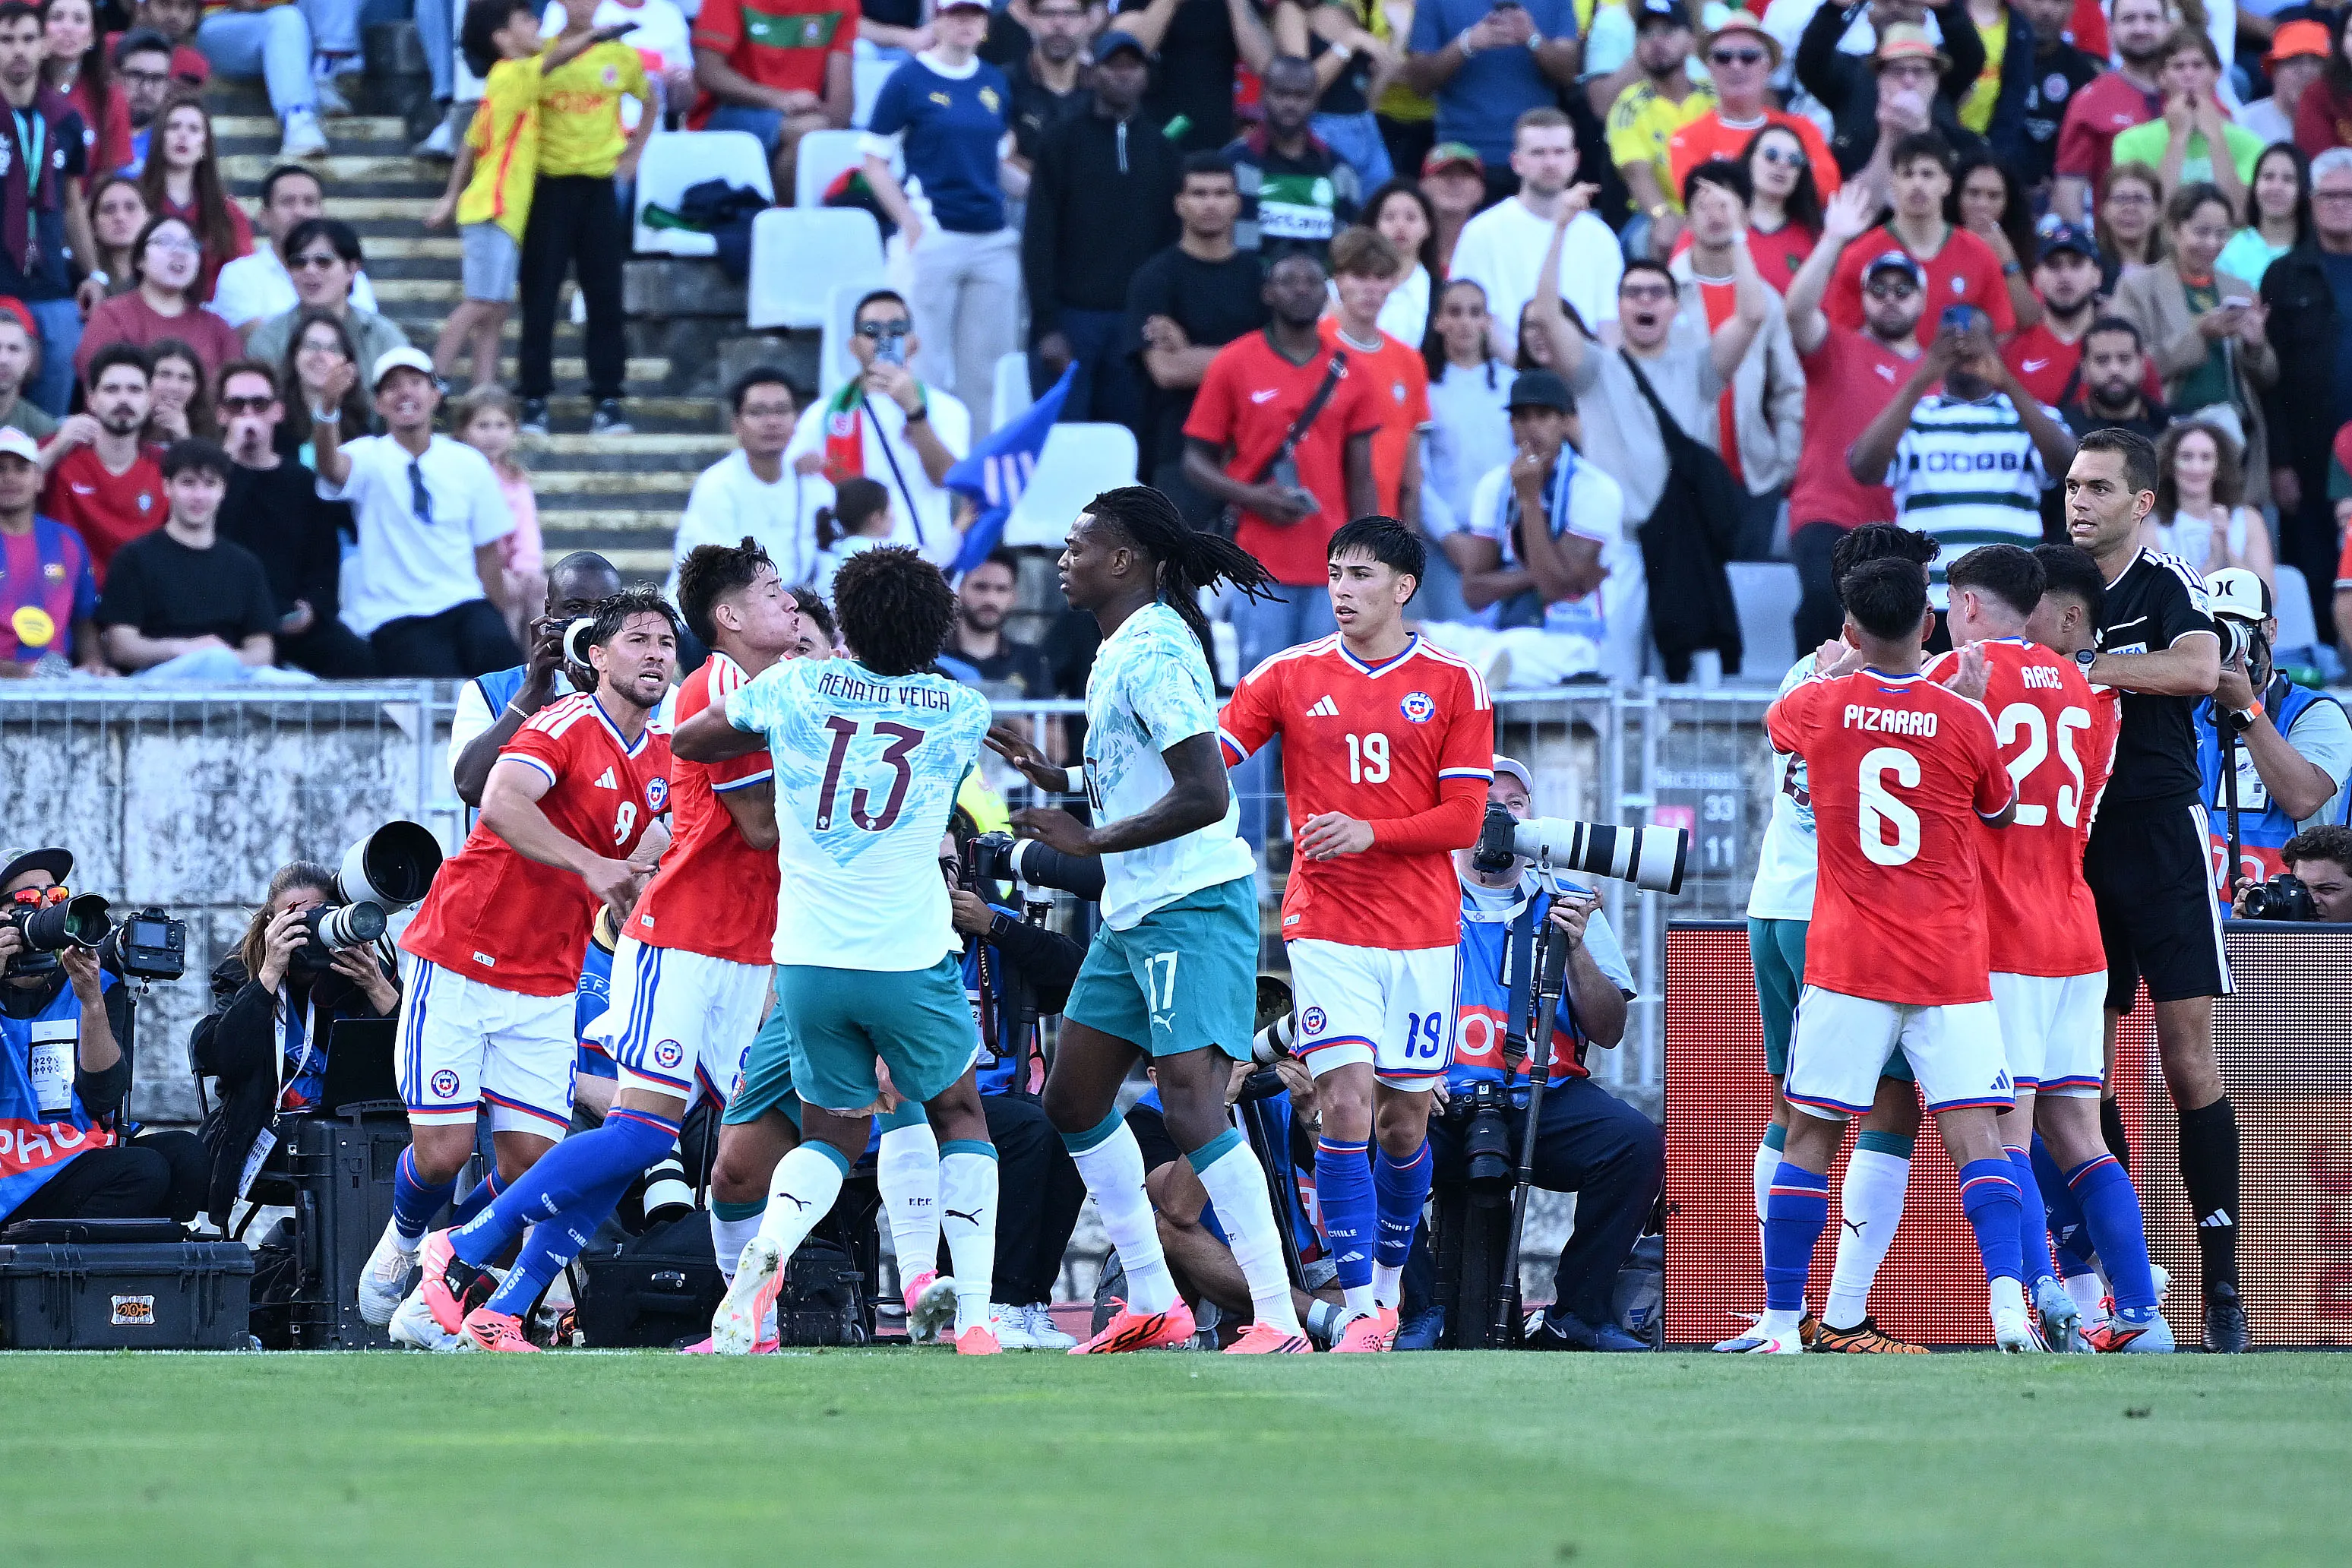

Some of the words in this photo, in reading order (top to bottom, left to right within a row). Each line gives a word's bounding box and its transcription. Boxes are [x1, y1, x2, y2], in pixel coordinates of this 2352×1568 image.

[818, 673, 890, 703] RENATO
[899, 687, 950, 713] VEIGA
[2021, 665, 2063, 690] ARCE
[1844, 703, 1938, 738] PIZARRO
[816, 715, 925, 831] 13
[1345, 732, 1390, 784] 19
[1997, 702, 2091, 828] 25
[1859, 747, 1921, 865] 6
[1706, 836, 1734, 867] 11
[980, 946, 989, 987] Canon
[1145, 950, 1178, 1013] 17
[1405, 1012, 1442, 1058] 19
[1327, 1228, 1358, 1238] CHILE
